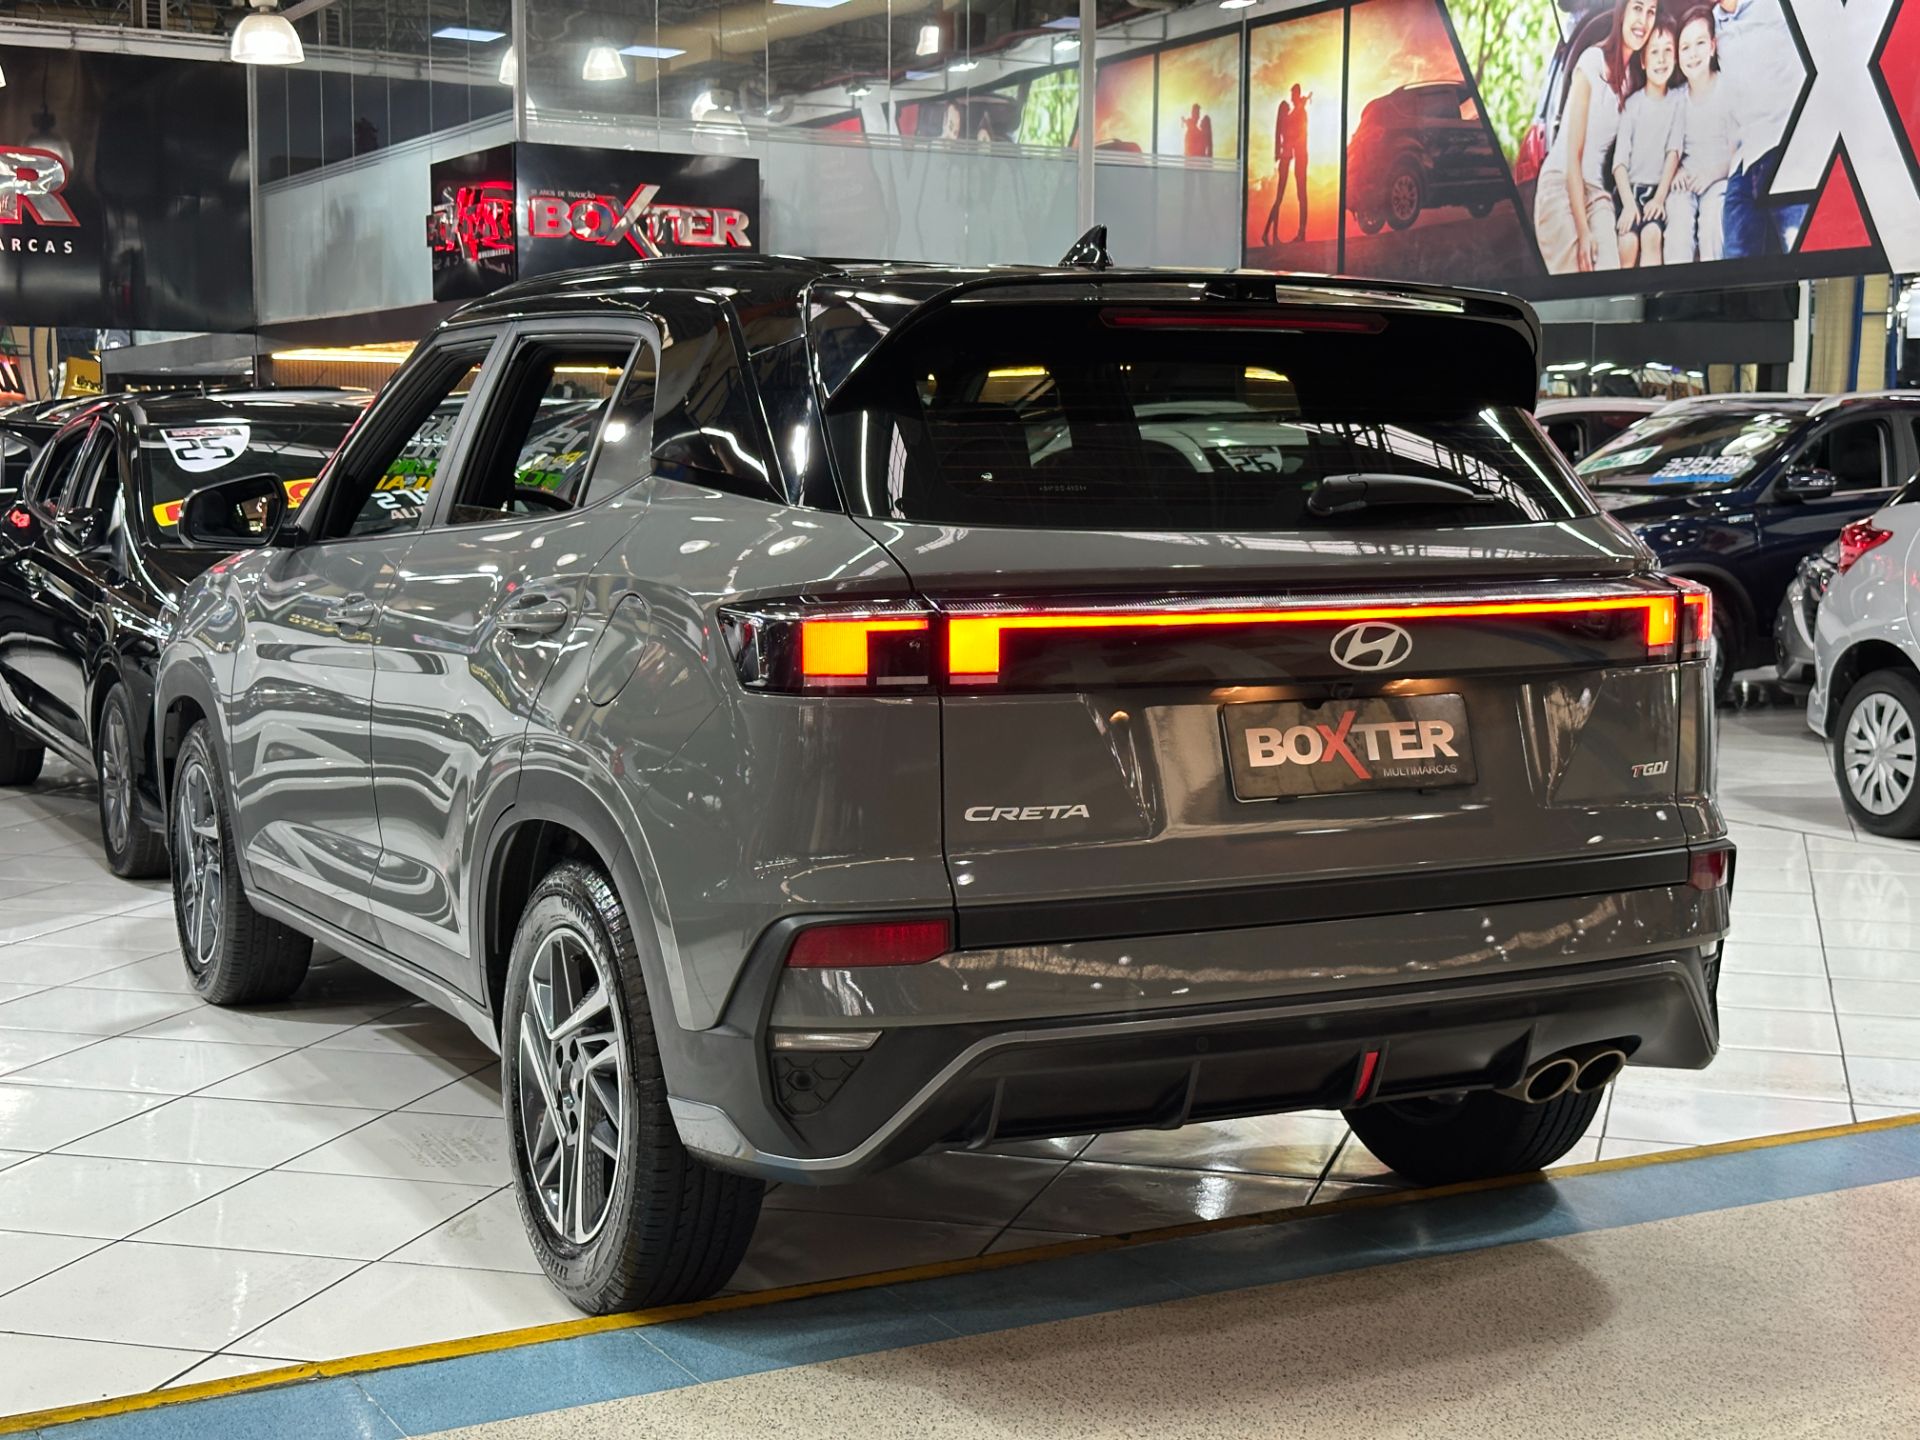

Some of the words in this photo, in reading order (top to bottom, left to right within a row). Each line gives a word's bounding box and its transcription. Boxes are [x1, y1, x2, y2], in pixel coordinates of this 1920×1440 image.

[567, 190, 597, 200] TRADIÇÃO
[528, 183, 752, 259] BOXTER
[170, 438, 236, 460] 25
[1245, 710, 1459, 780] BOXTER
[1383, 764, 1458, 777] MULTIMARCAS
[1631, 760, 1669, 778] TGDI
[964, 804, 1090, 822] CRETA
